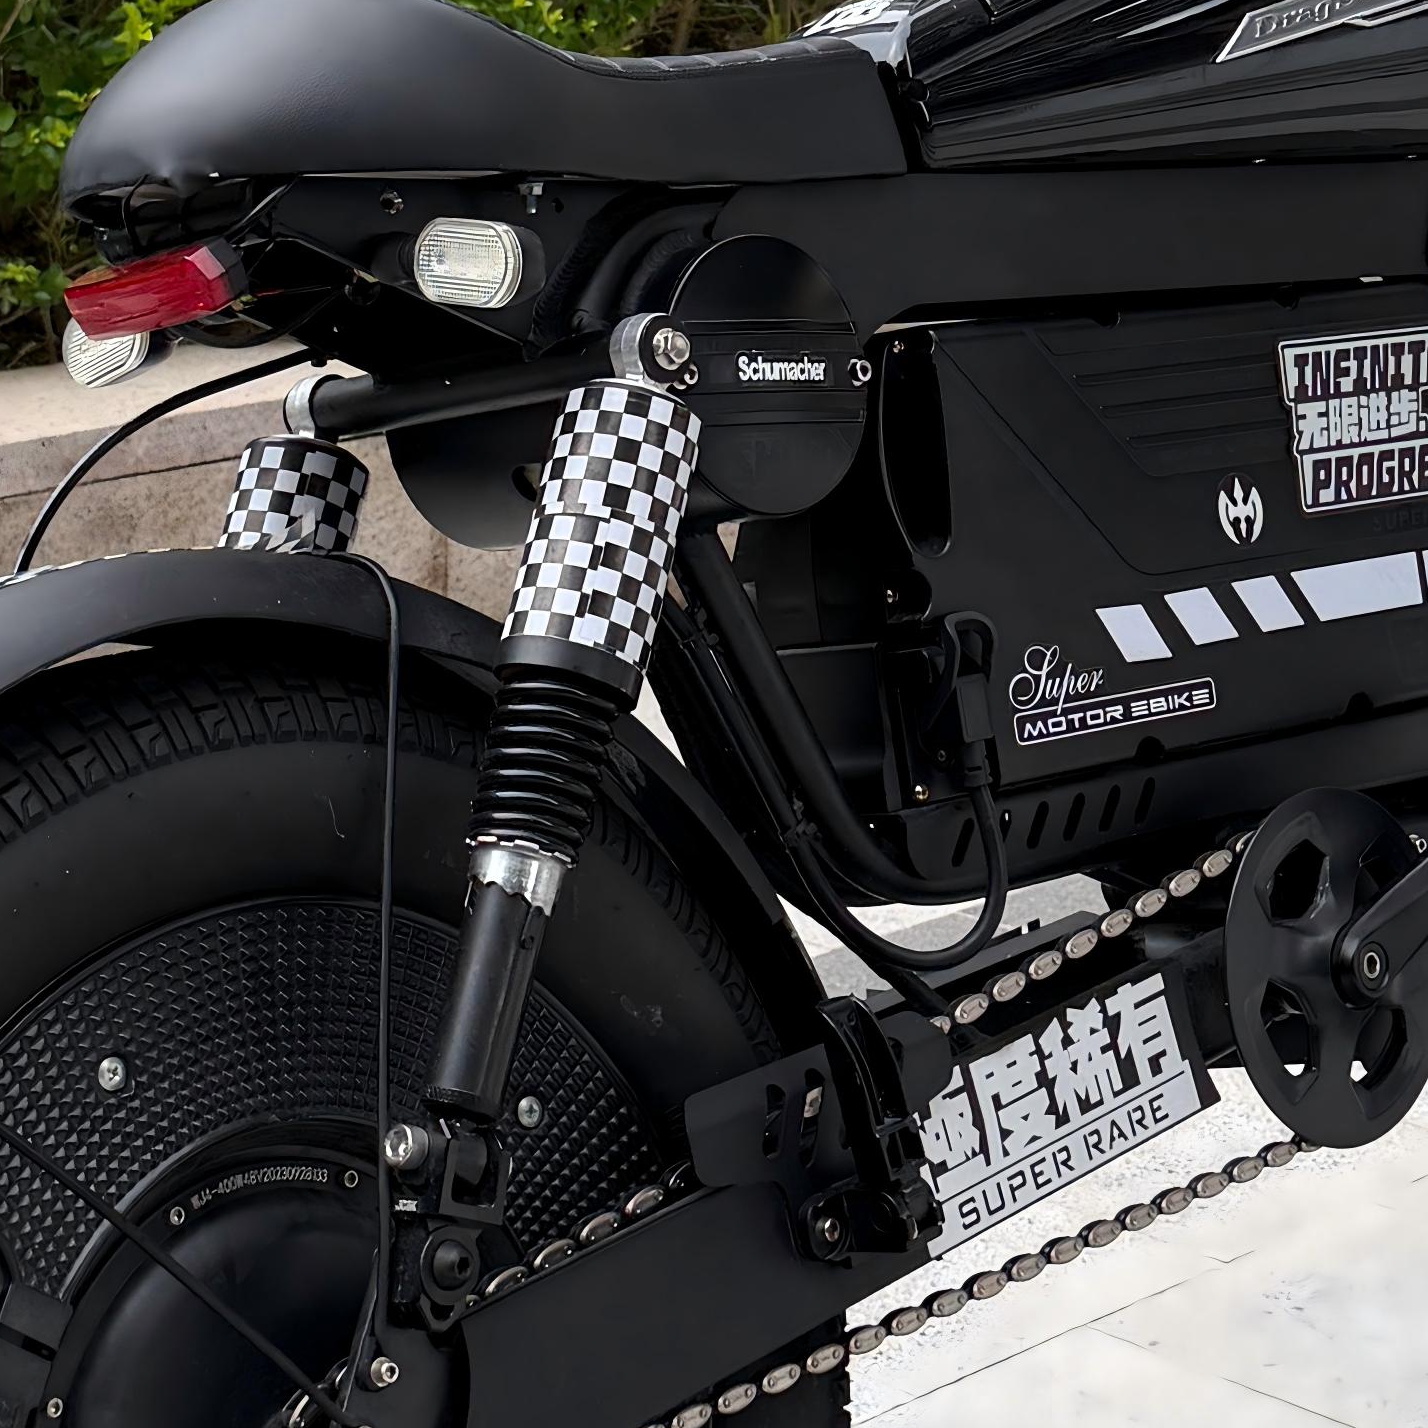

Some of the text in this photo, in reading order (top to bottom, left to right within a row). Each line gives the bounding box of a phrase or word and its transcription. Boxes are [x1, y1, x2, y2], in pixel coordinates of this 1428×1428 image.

[738, 355, 826, 381] Schumacher
[1009, 645, 1104, 716] Super
[1023, 688, 1211, 739] MOTOR EBIKE
[958, 1093, 1170, 1230] SUPER RARE
